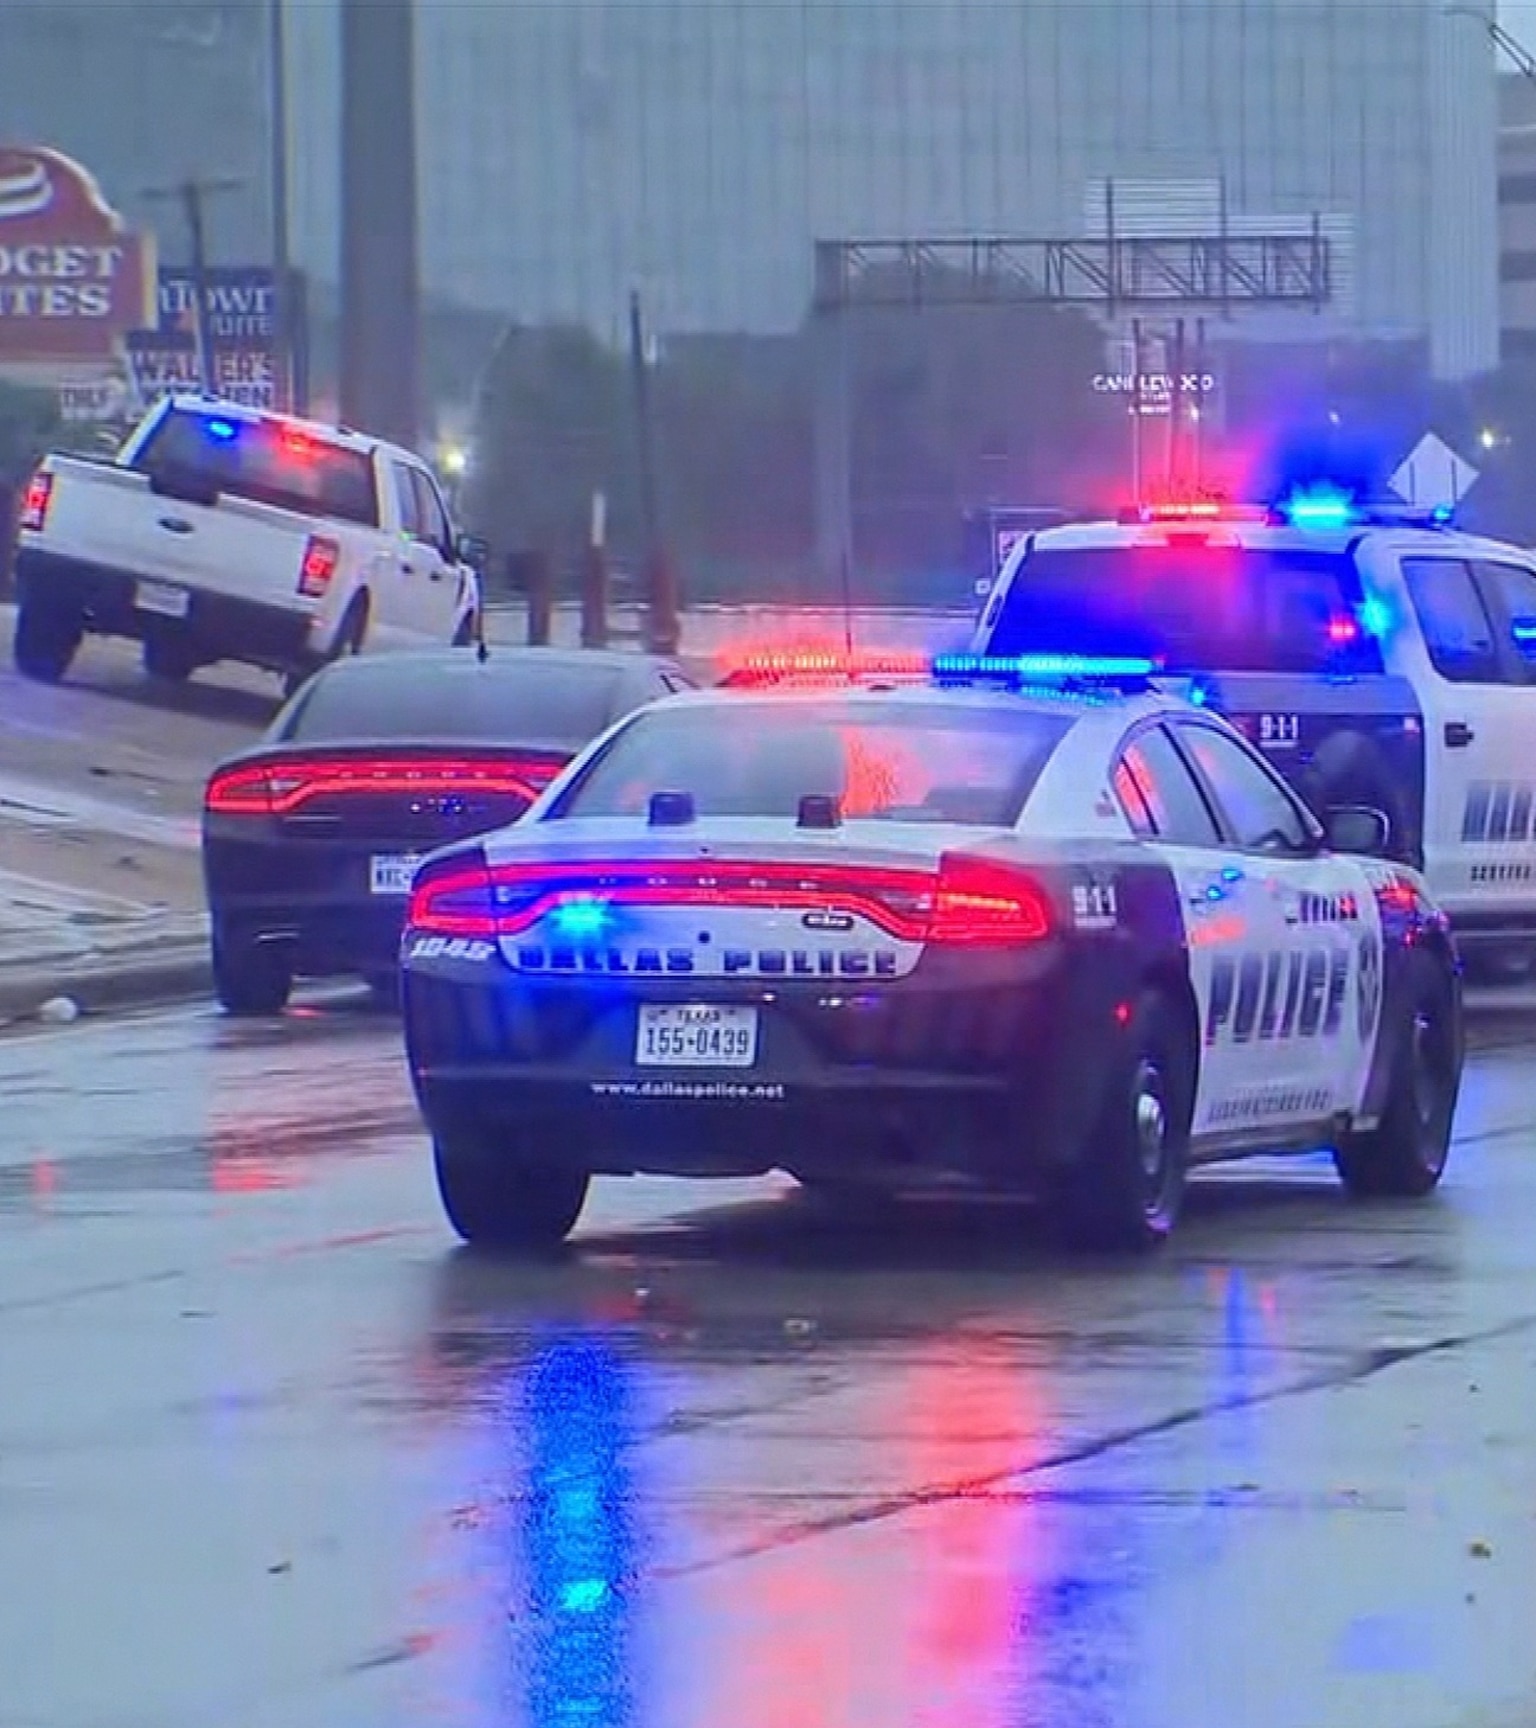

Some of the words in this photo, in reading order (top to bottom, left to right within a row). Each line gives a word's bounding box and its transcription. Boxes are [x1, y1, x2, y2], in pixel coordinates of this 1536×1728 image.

[517, 947, 694, 972] DALLAS
[723, 949, 896, 974] POLICE
[592, 1082, 785, 1099] www.dallaspolice.net
